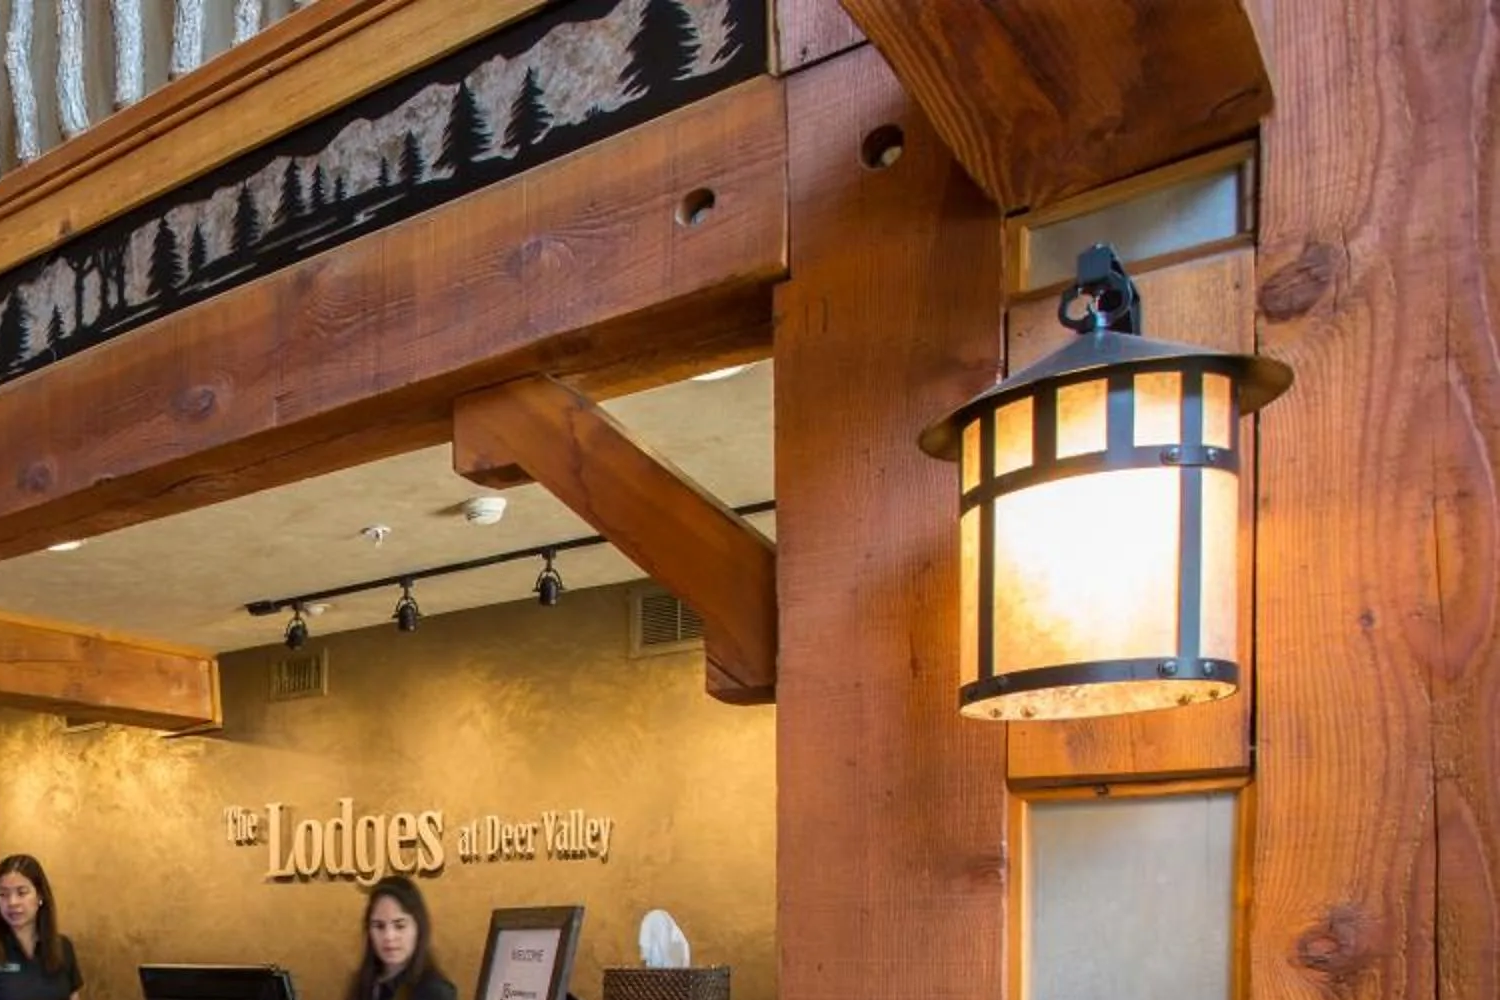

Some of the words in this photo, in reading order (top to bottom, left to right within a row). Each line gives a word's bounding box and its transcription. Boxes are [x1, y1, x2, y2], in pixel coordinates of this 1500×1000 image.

[224, 805, 258, 842] The
[264, 797, 446, 886] Lodges
[457, 824, 478, 856] at
[486, 814, 539, 855] Deer
[542, 809, 612, 862] Valley
